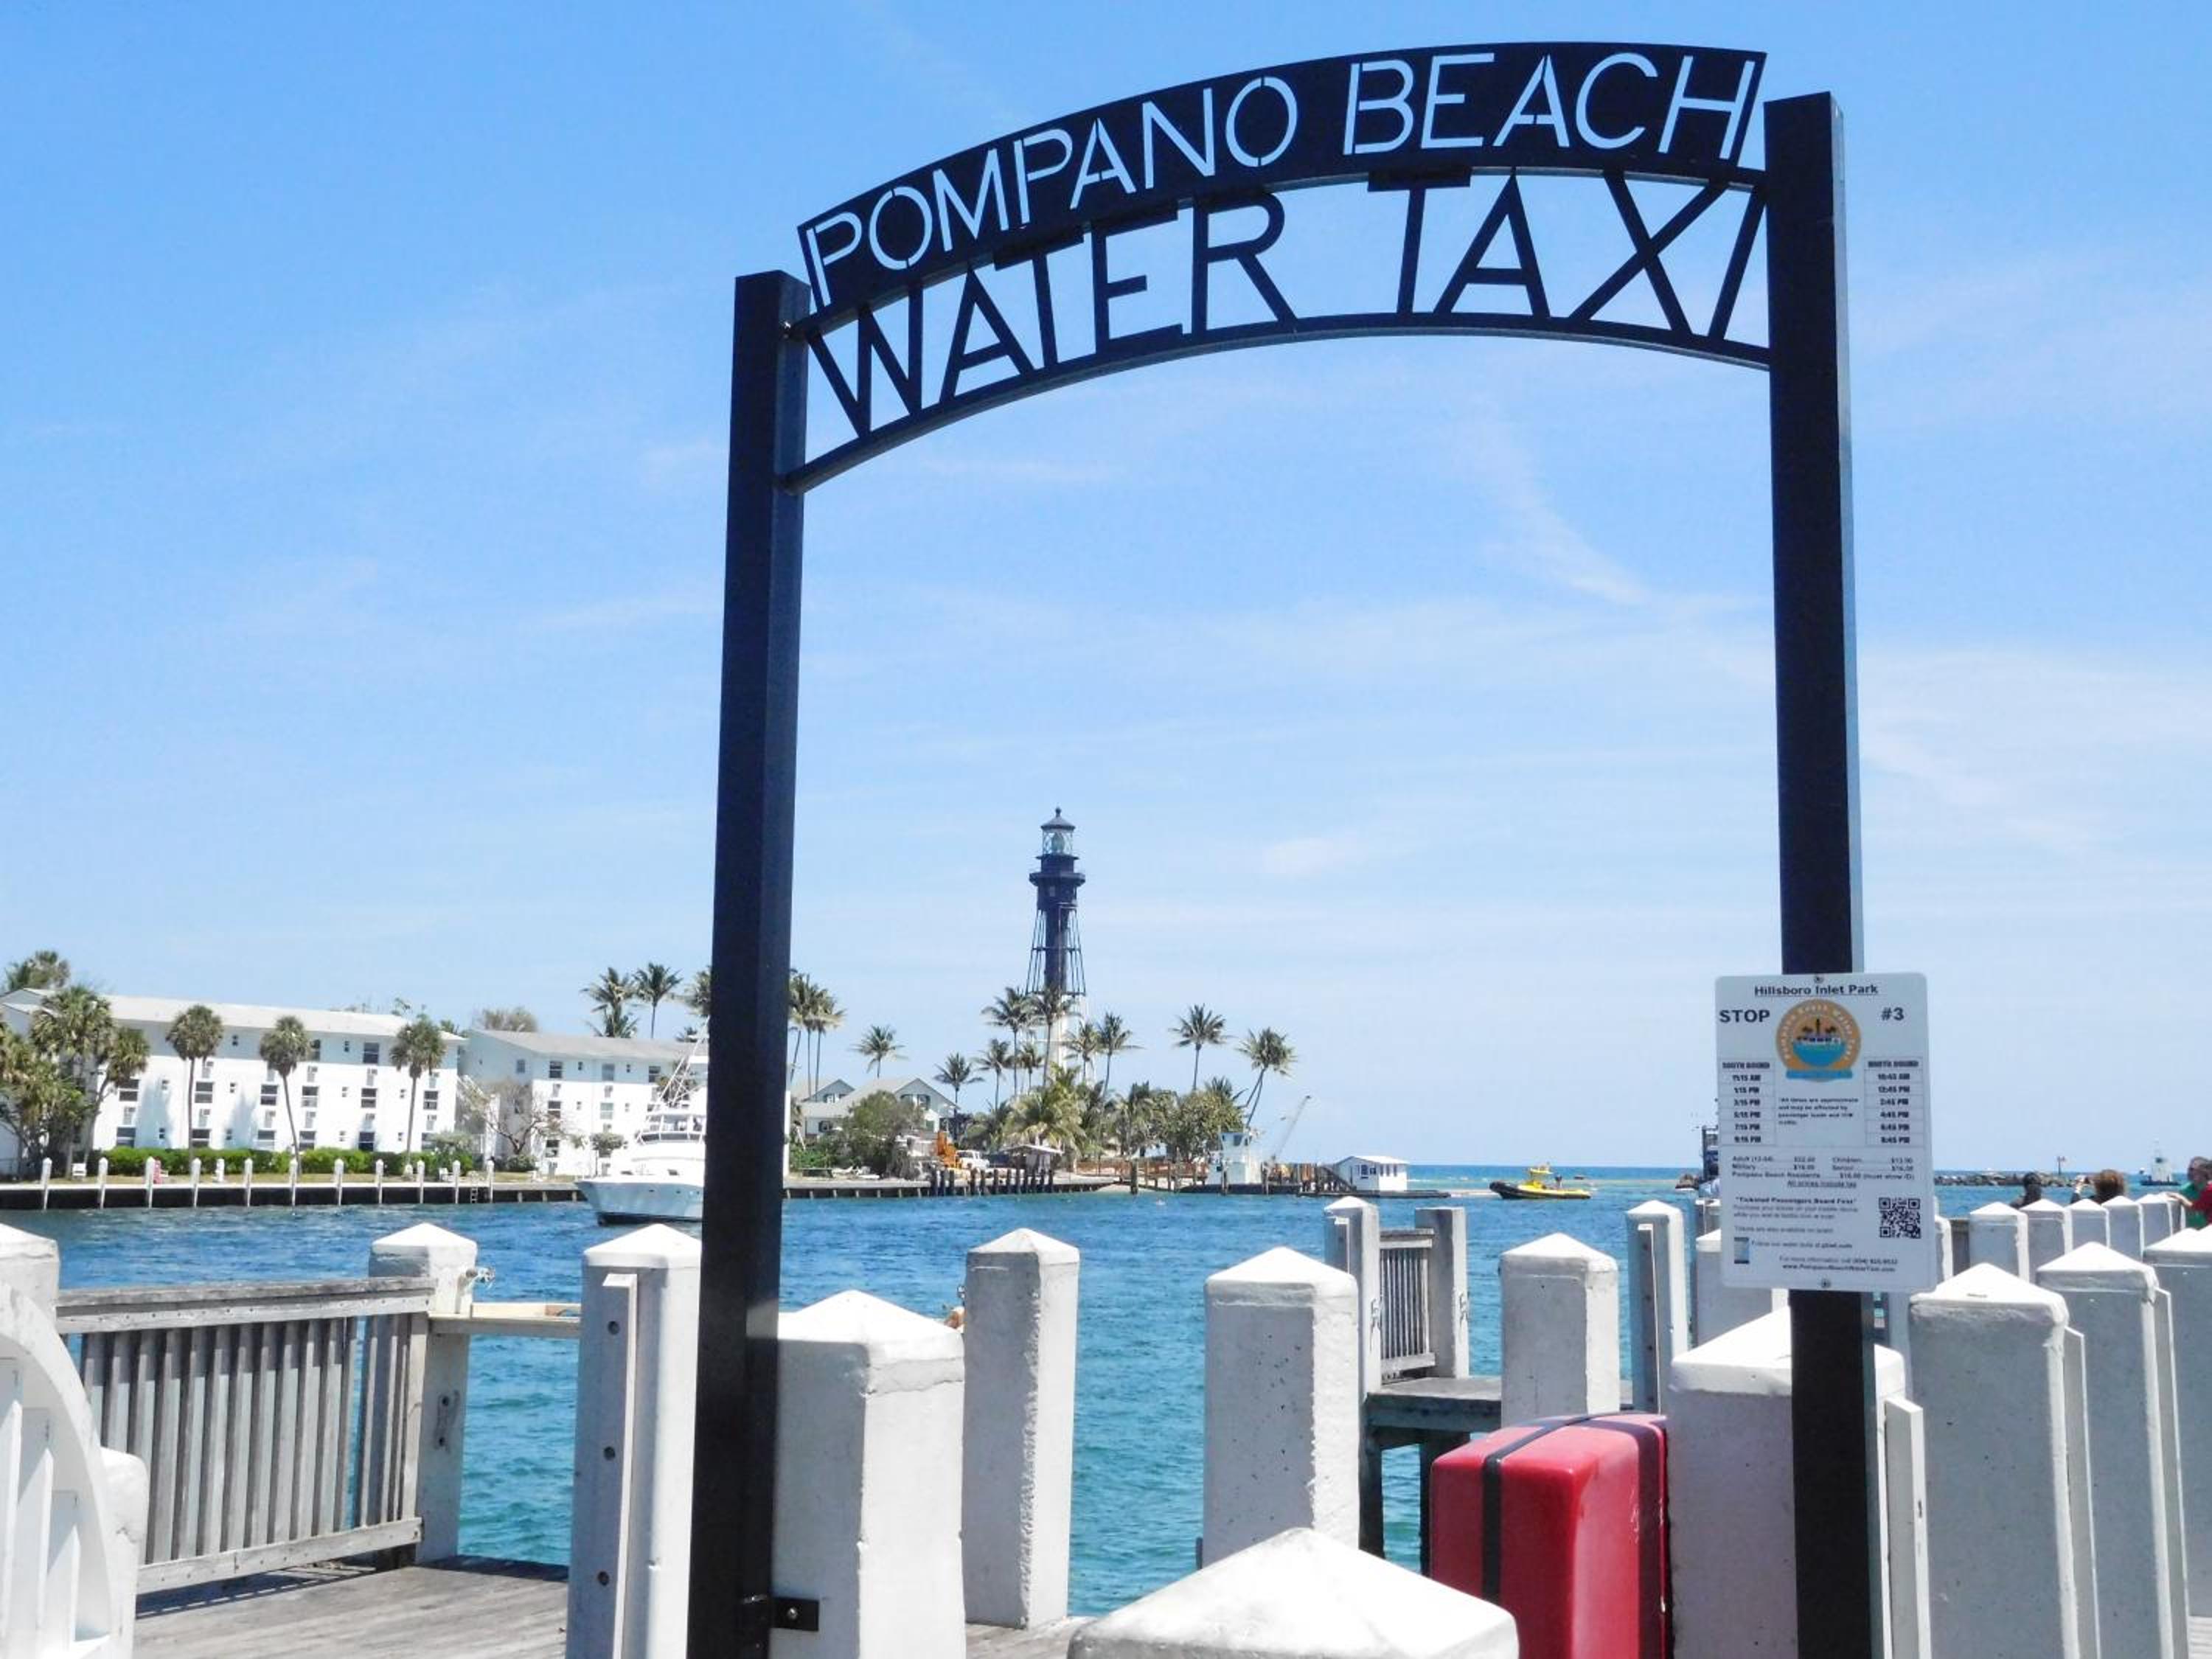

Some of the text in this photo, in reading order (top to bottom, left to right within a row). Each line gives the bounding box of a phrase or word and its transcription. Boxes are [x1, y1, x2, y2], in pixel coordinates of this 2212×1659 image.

[806, 52, 1756, 308] POMPANO BEACH
[807, 166, 1767, 439] WATER TAXI
[1754, 984, 1878, 995] Hillsboro Inlet Park
[1719, 1009, 1770, 1023] STOP
[1881, 1006, 1904, 1021] #3
